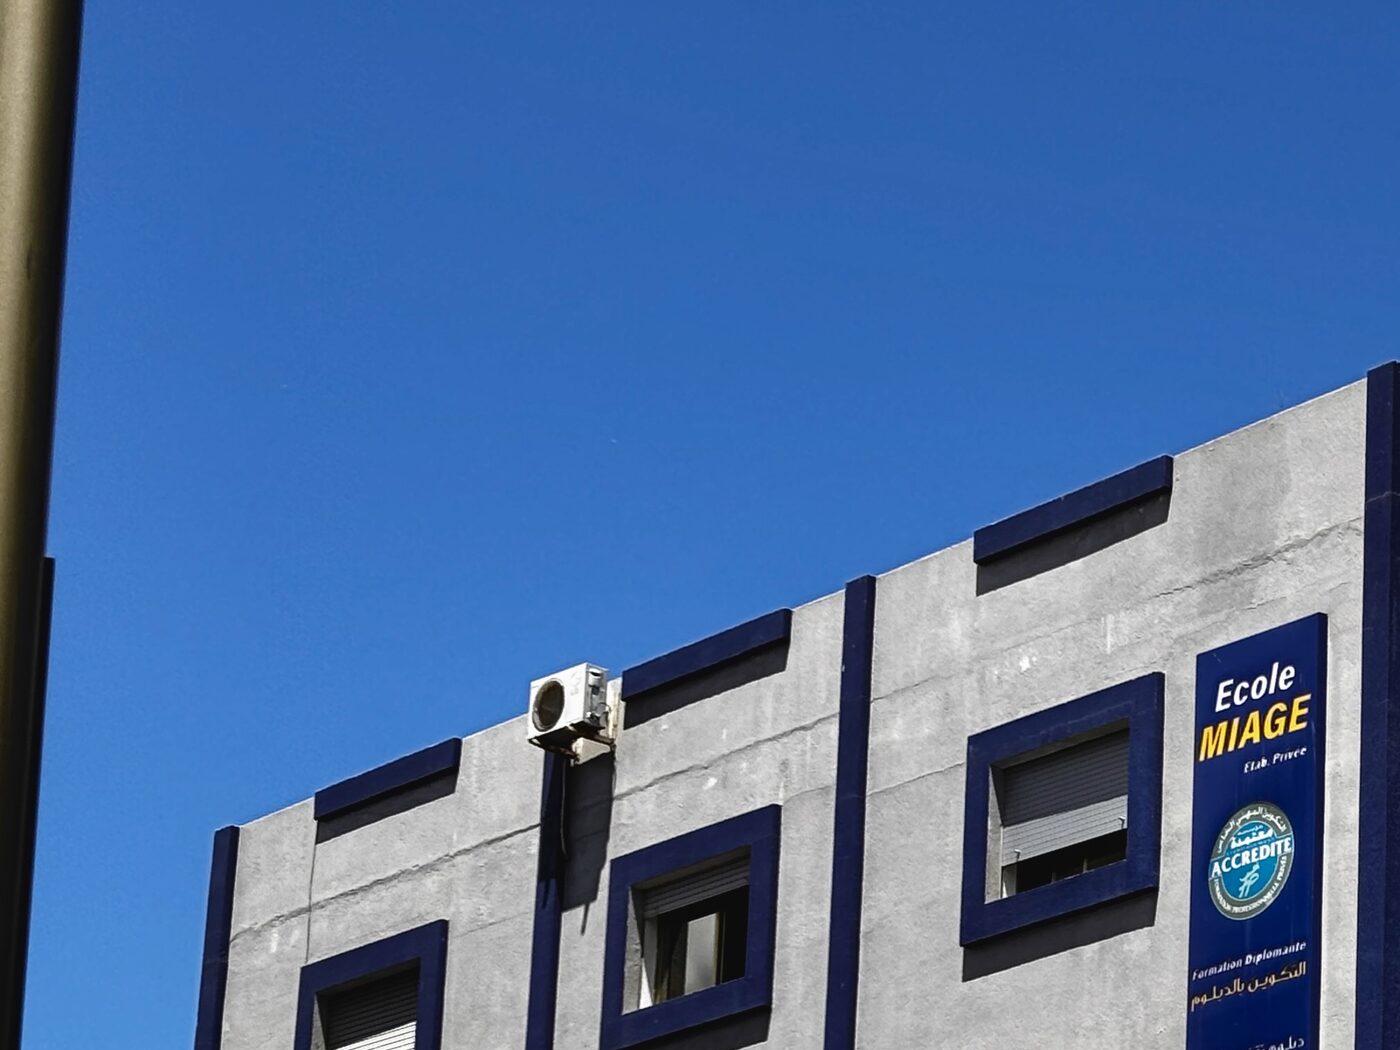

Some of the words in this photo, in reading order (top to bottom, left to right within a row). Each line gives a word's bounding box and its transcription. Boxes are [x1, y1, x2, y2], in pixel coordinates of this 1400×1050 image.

[1215, 662, 1295, 712] Ecole
[1199, 694, 1311, 762] MIAGE
[1211, 837, 1292, 878] ACCREDITE
[1192, 958, 1243, 981] Formation
[1247, 961, 1307, 993] التكوين
[1190, 978, 1245, 1012] بالدبلوم
